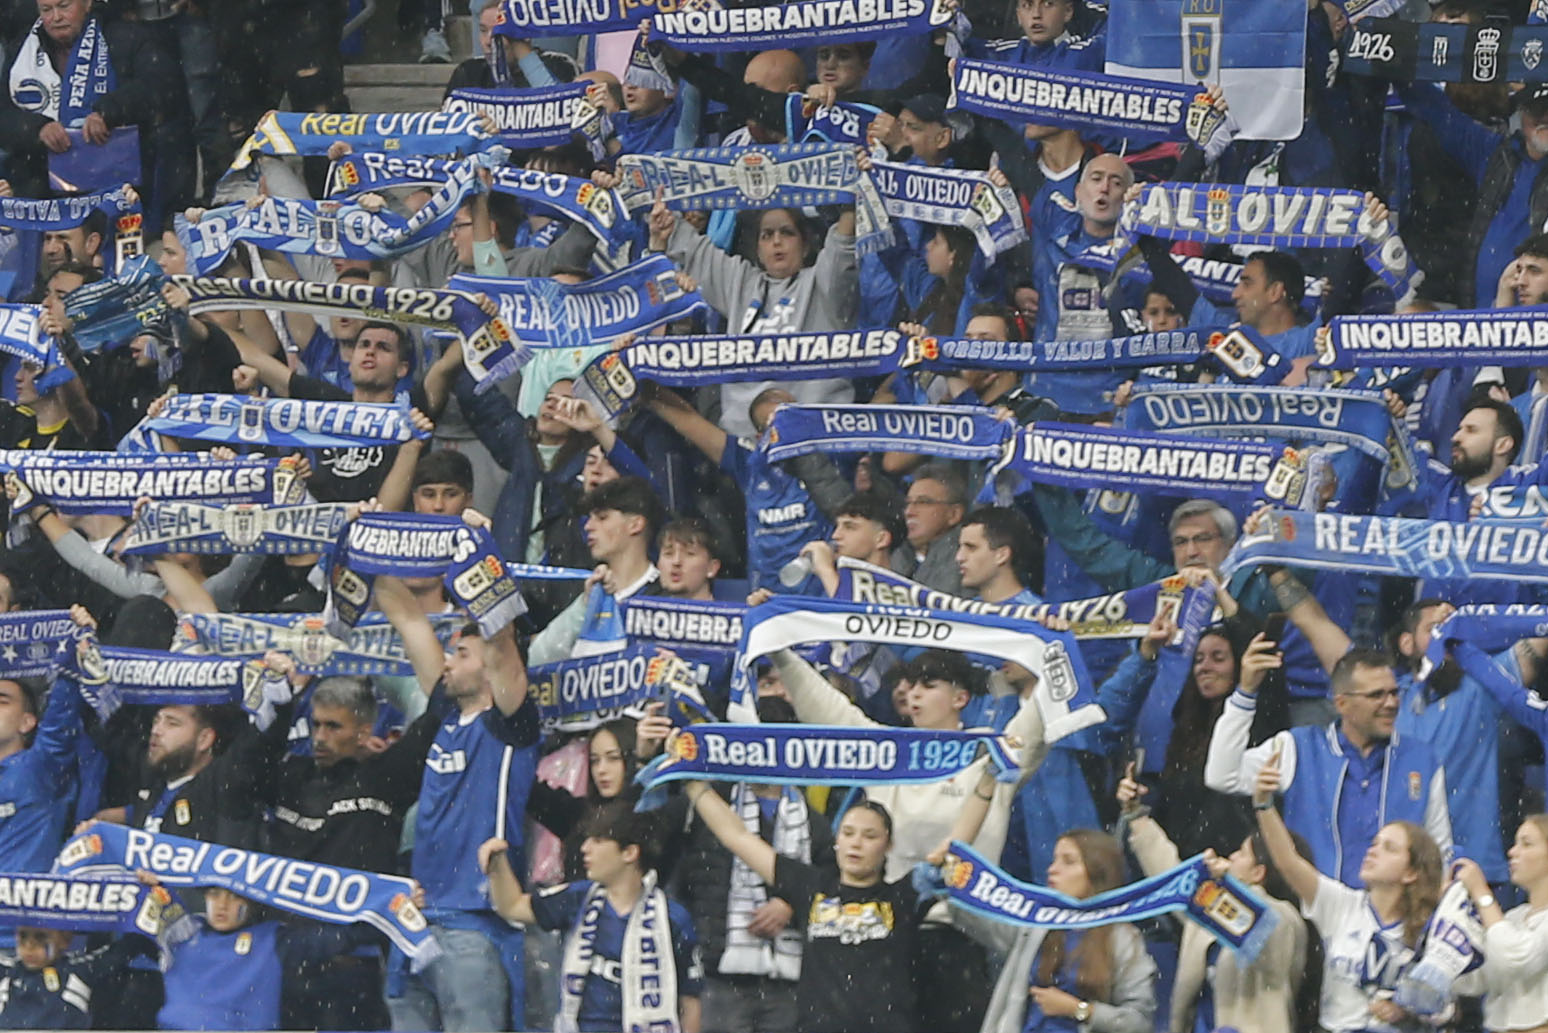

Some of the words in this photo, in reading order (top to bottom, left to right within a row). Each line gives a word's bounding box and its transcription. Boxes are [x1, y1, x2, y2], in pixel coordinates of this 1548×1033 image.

[1349, 30, 1394, 61] 1926
[68, 64, 90, 108] PEÑA
[958, 66, 1182, 126] INQUEBRANTABLES
[906, 172, 971, 207] OVIEDO
[185, 274, 245, 299] Real
[250, 279, 373, 305] OVIEDO
[384, 288, 455, 319] 1926
[501, 292, 556, 331] REAL
[567, 284, 640, 329] OVIEDO
[629, 329, 898, 368] INQUEBRANTABLES
[1110, 338, 1124, 360] Y
[822, 409, 878, 435] Real
[887, 412, 974, 443] OVIEDO
[1145, 392, 1262, 427] OVIEDO
[1025, 434, 1271, 482] INQUEBRANTABLES
[26, 467, 265, 497] INQUEBRANTABLES
[757, 502, 805, 526] NMR
[1315, 518, 1403, 556] REAL
[627, 607, 743, 645] INQUEBRA
[845, 614, 953, 642] OVIEDO
[564, 655, 646, 704] OVIEDO
[706, 736, 778, 769] Real
[785, 738, 895, 770] OVIEDO
[908, 738, 977, 770] 1926
[127, 829, 201, 873] Real
[213, 847, 370, 913] OVIEDO
[971, 870, 1035, 920] Real
